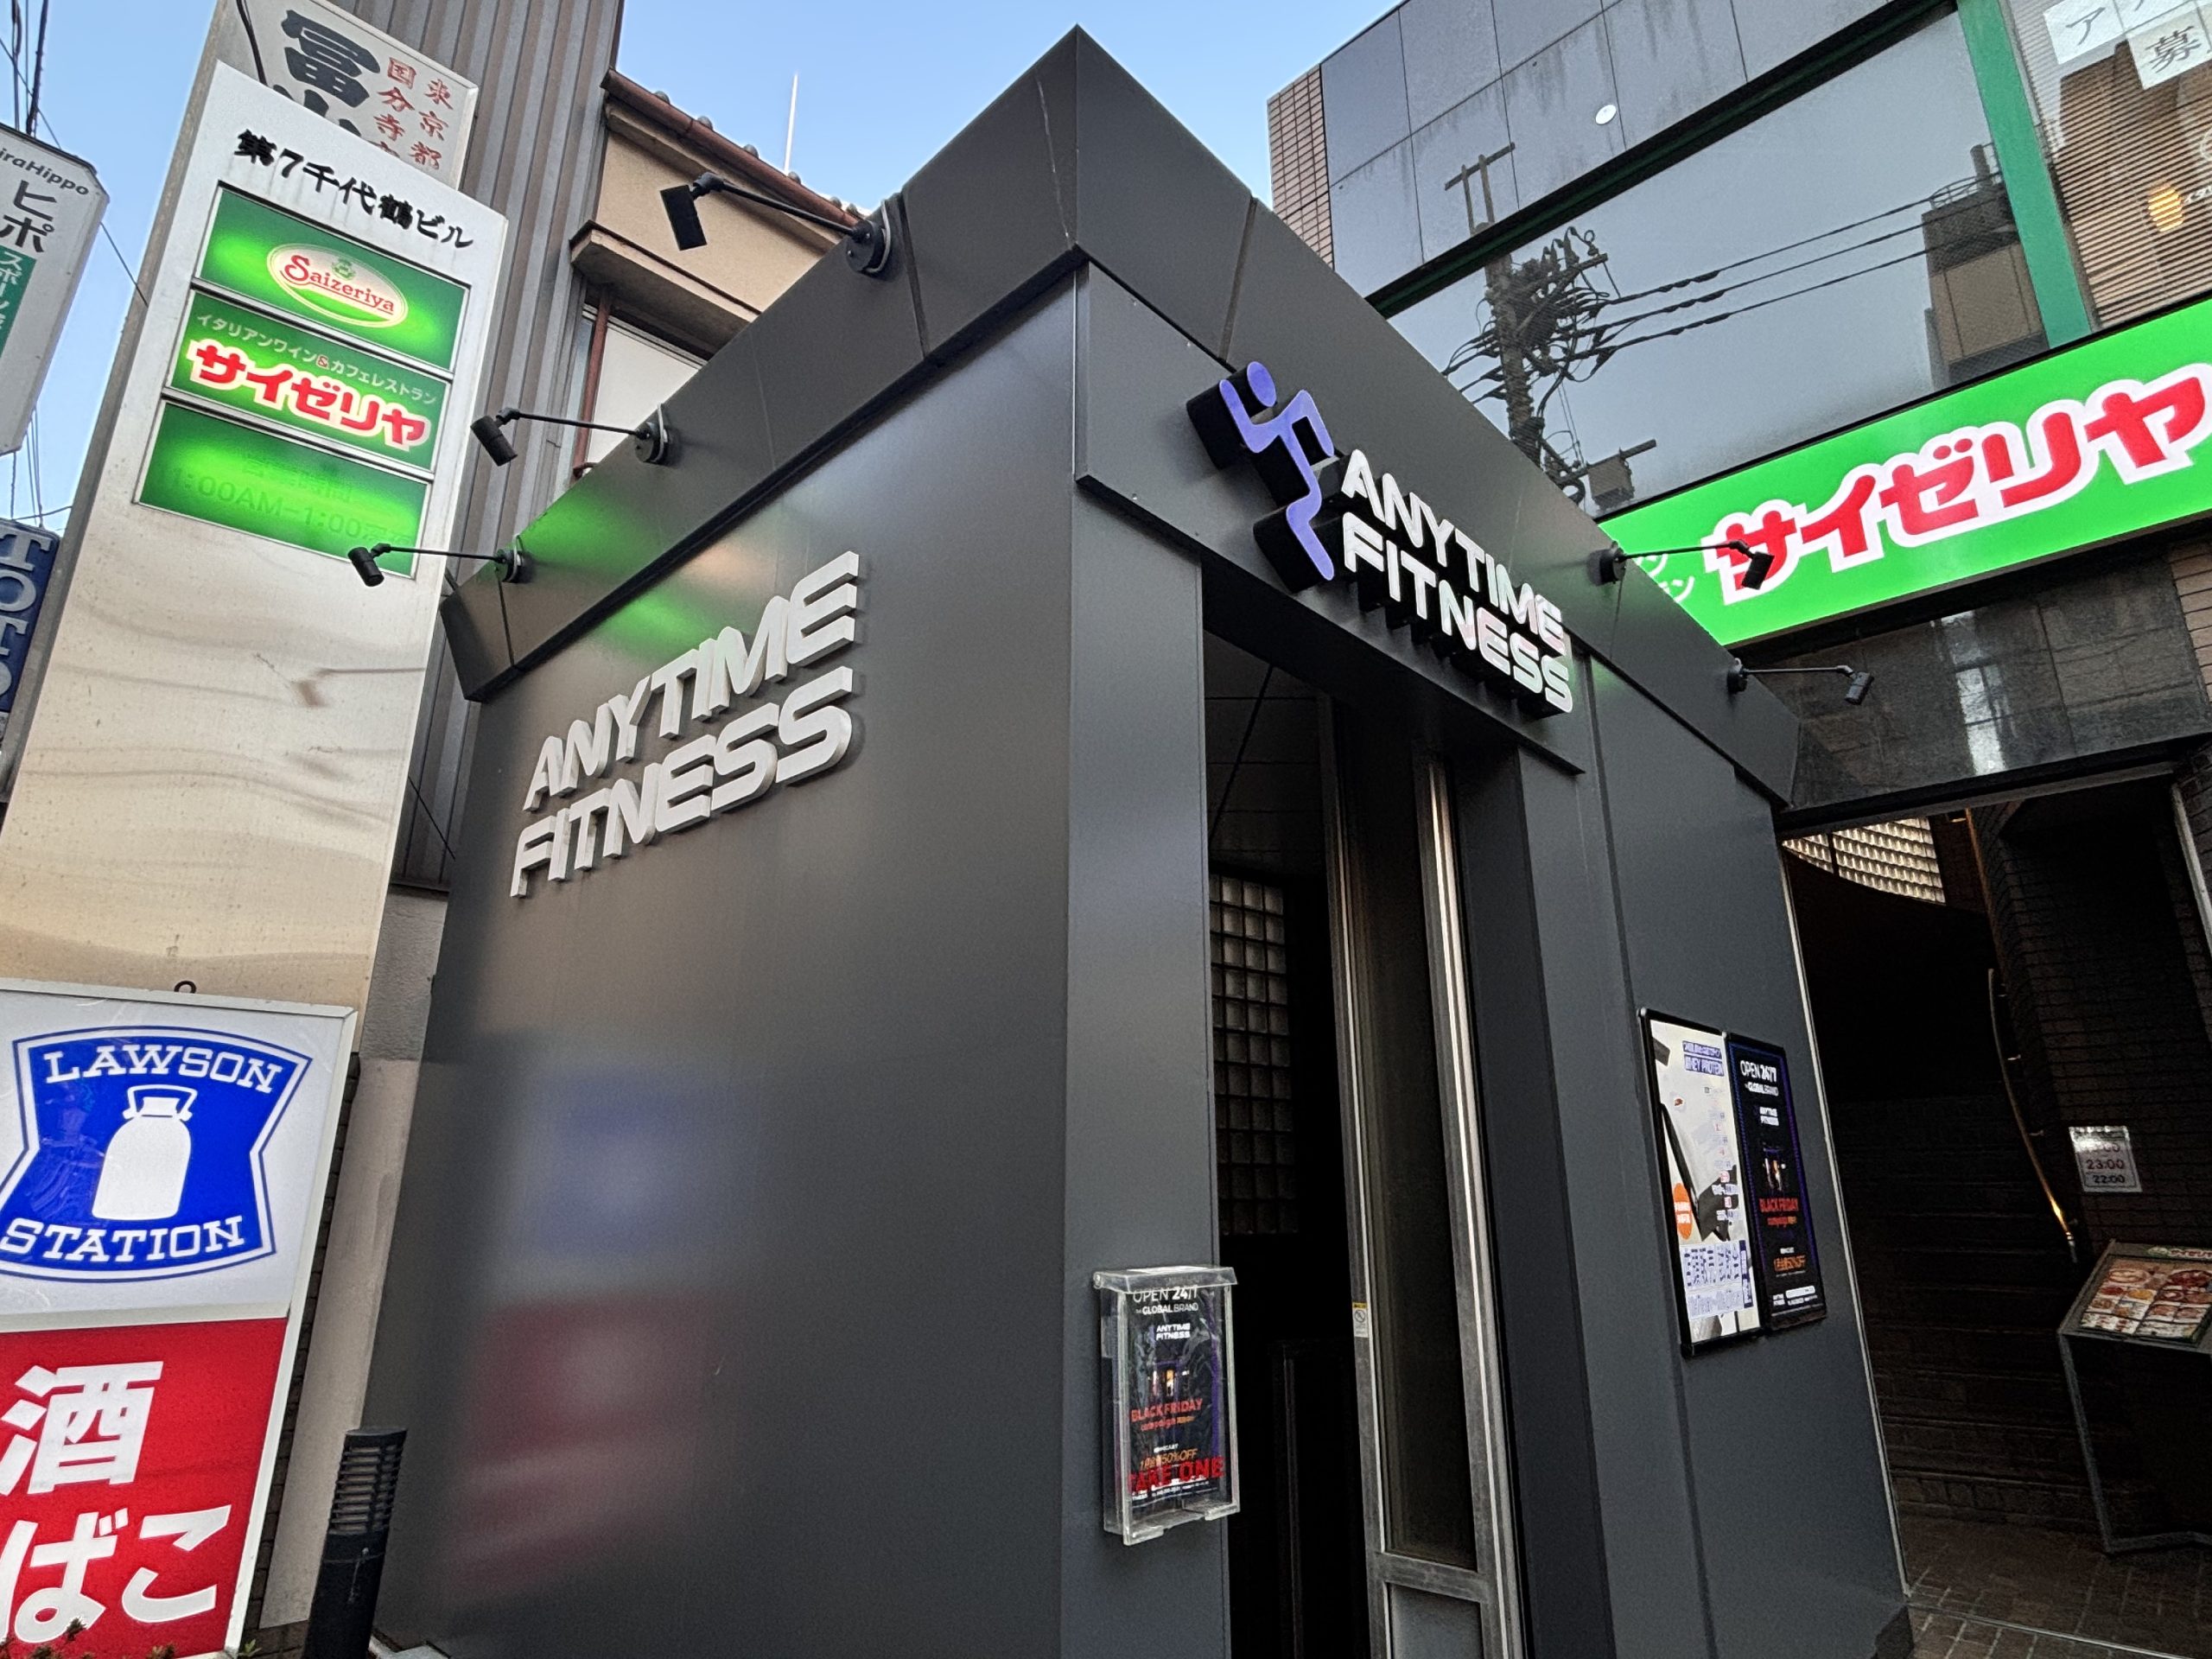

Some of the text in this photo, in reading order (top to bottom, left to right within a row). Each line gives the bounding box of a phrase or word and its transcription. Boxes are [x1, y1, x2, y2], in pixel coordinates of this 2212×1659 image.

[409, 79, 454, 170] 東京都
[233, 129, 474, 248] 第7千代鶴ビル
[281, 254, 394, 314] Saizeriya
[194, 343, 429, 447] サイゼリヤ
[197, 314, 437, 405] イタリアンワイン&カフェレストラン
[1714, 375, 2208, 593] サイゼリヤ
[1341, 448, 1567, 657] ANYTIME
[1342, 511, 1573, 714] FITNESS
[523, 550, 860, 811] ANYTIME
[510, 665, 854, 898] FITNESS
[43, 1044, 283, 1094] LAWSON
[1739, 1059, 1760, 1078] OPEN
[2087, 1159, 2125, 1170] 23:00
[0, 1215, 245, 1263] STATION
[1133, 1286, 1169, 1303] OPEN
[1142, 1304, 1173, 1315] GLOBAL
[1173, 1302, 1199, 1313] BRAND
[1156, 1323, 1191, 1332] ANYTIME
[1156, 1331, 1191, 1341] FITNESS
[0, 1361, 164, 1497] 酒
[1131, 1405, 1163, 1422] BLACK
[1164, 1398, 1203, 1414] FRIDAY
[1128, 1465, 1172, 1493] TAKE
[1179, 1455, 1224, 1482] ONE
[0, 1503, 232, 1643] ばこ
